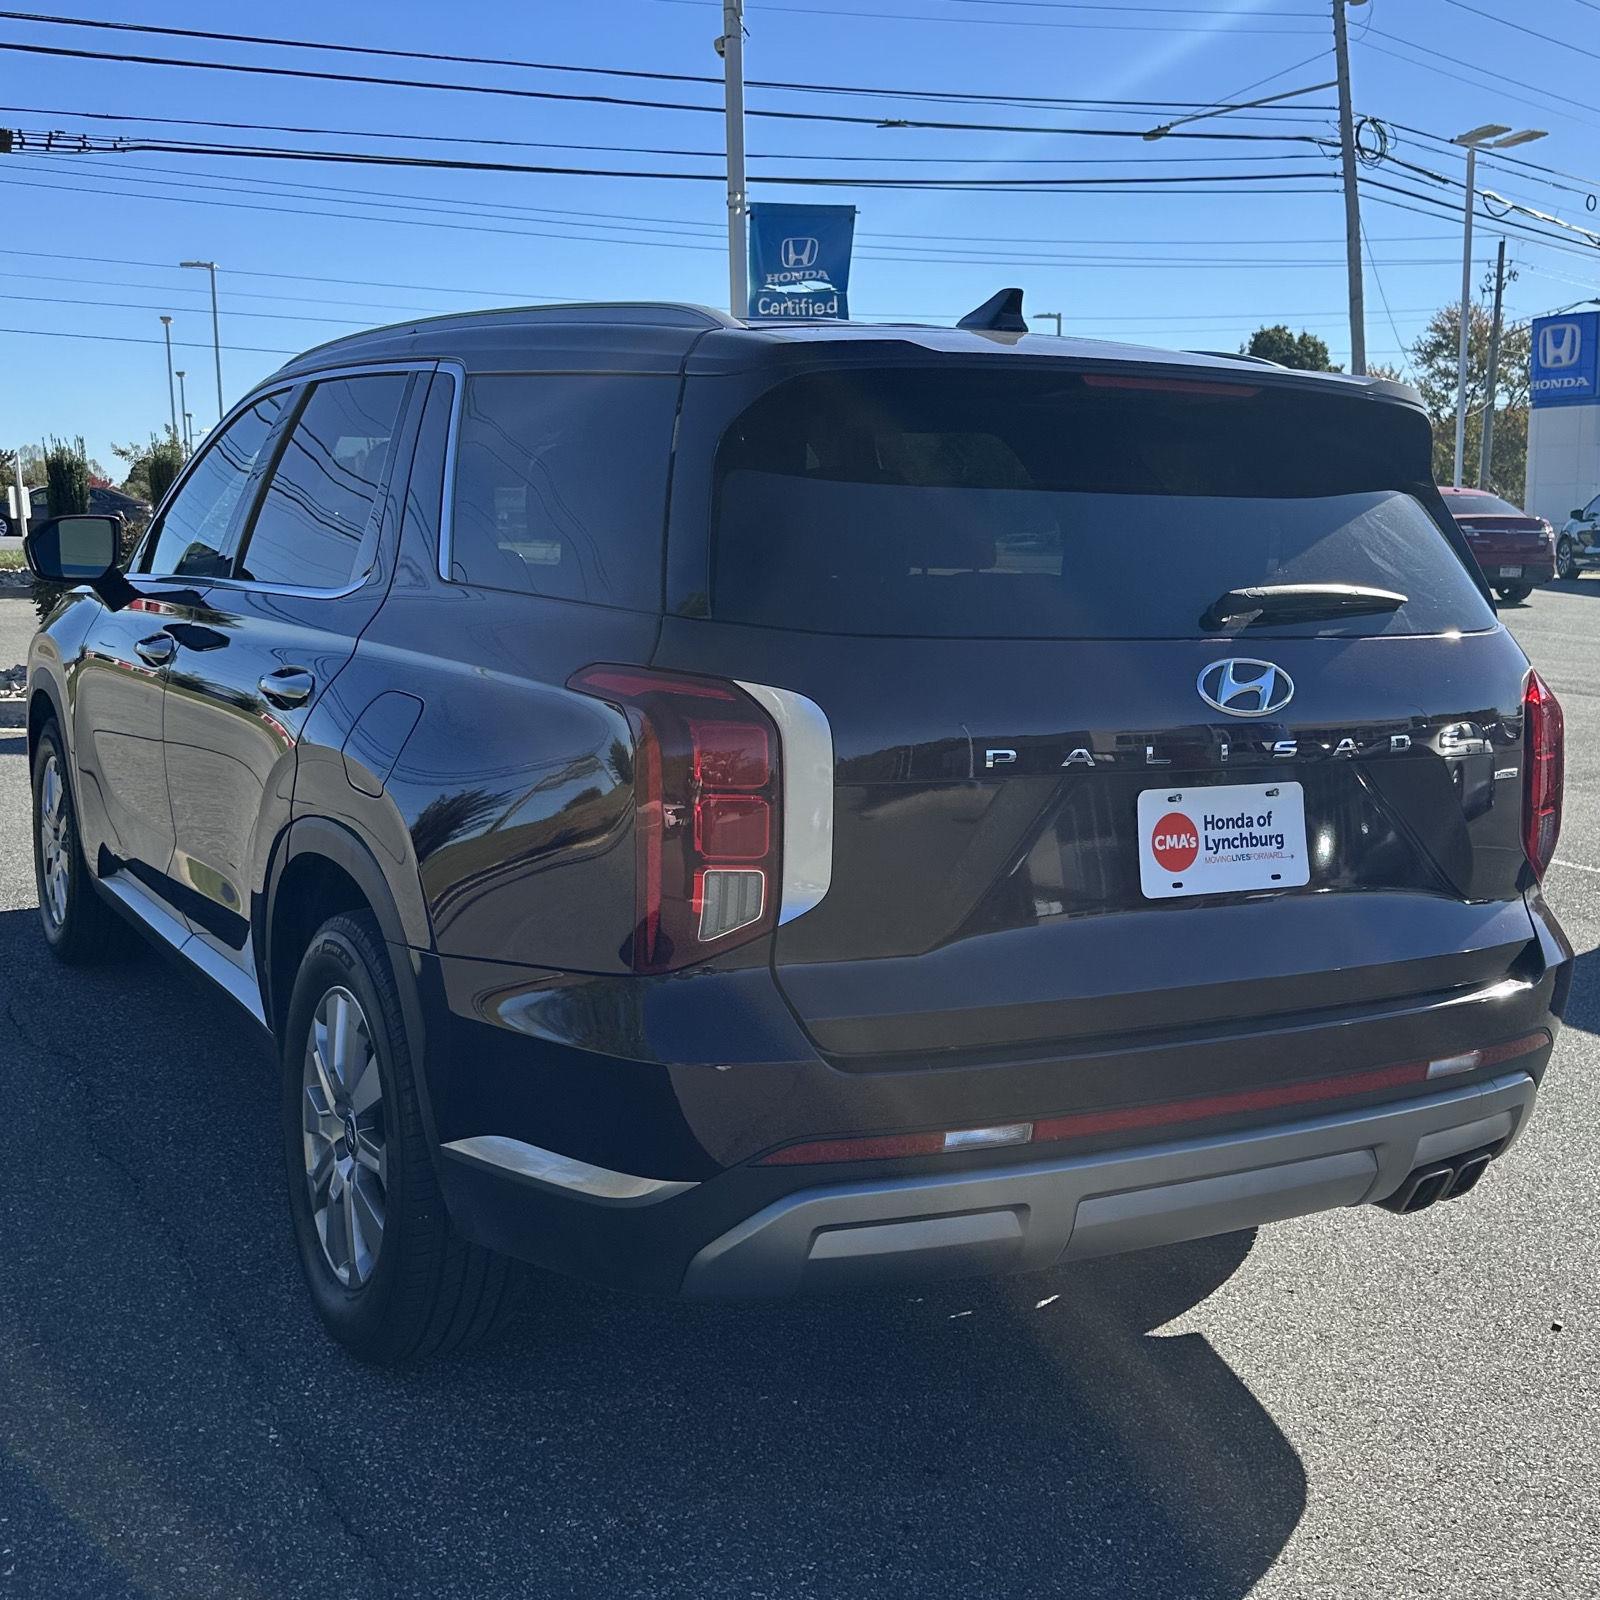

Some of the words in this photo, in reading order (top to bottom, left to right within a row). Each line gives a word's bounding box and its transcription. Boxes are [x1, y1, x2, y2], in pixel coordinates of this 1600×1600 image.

[766, 270, 830, 283] HONDA
[758, 295, 838, 315] Certified
[1531, 377, 1590, 391] HONDA
[985, 731, 1460, 768] PALISADE
[1203, 812, 1254, 831] Honda
[1257, 811, 1273, 827] of
[1154, 832, 1197, 851] CMA's
[1204, 832, 1285, 854] Lynchburg
